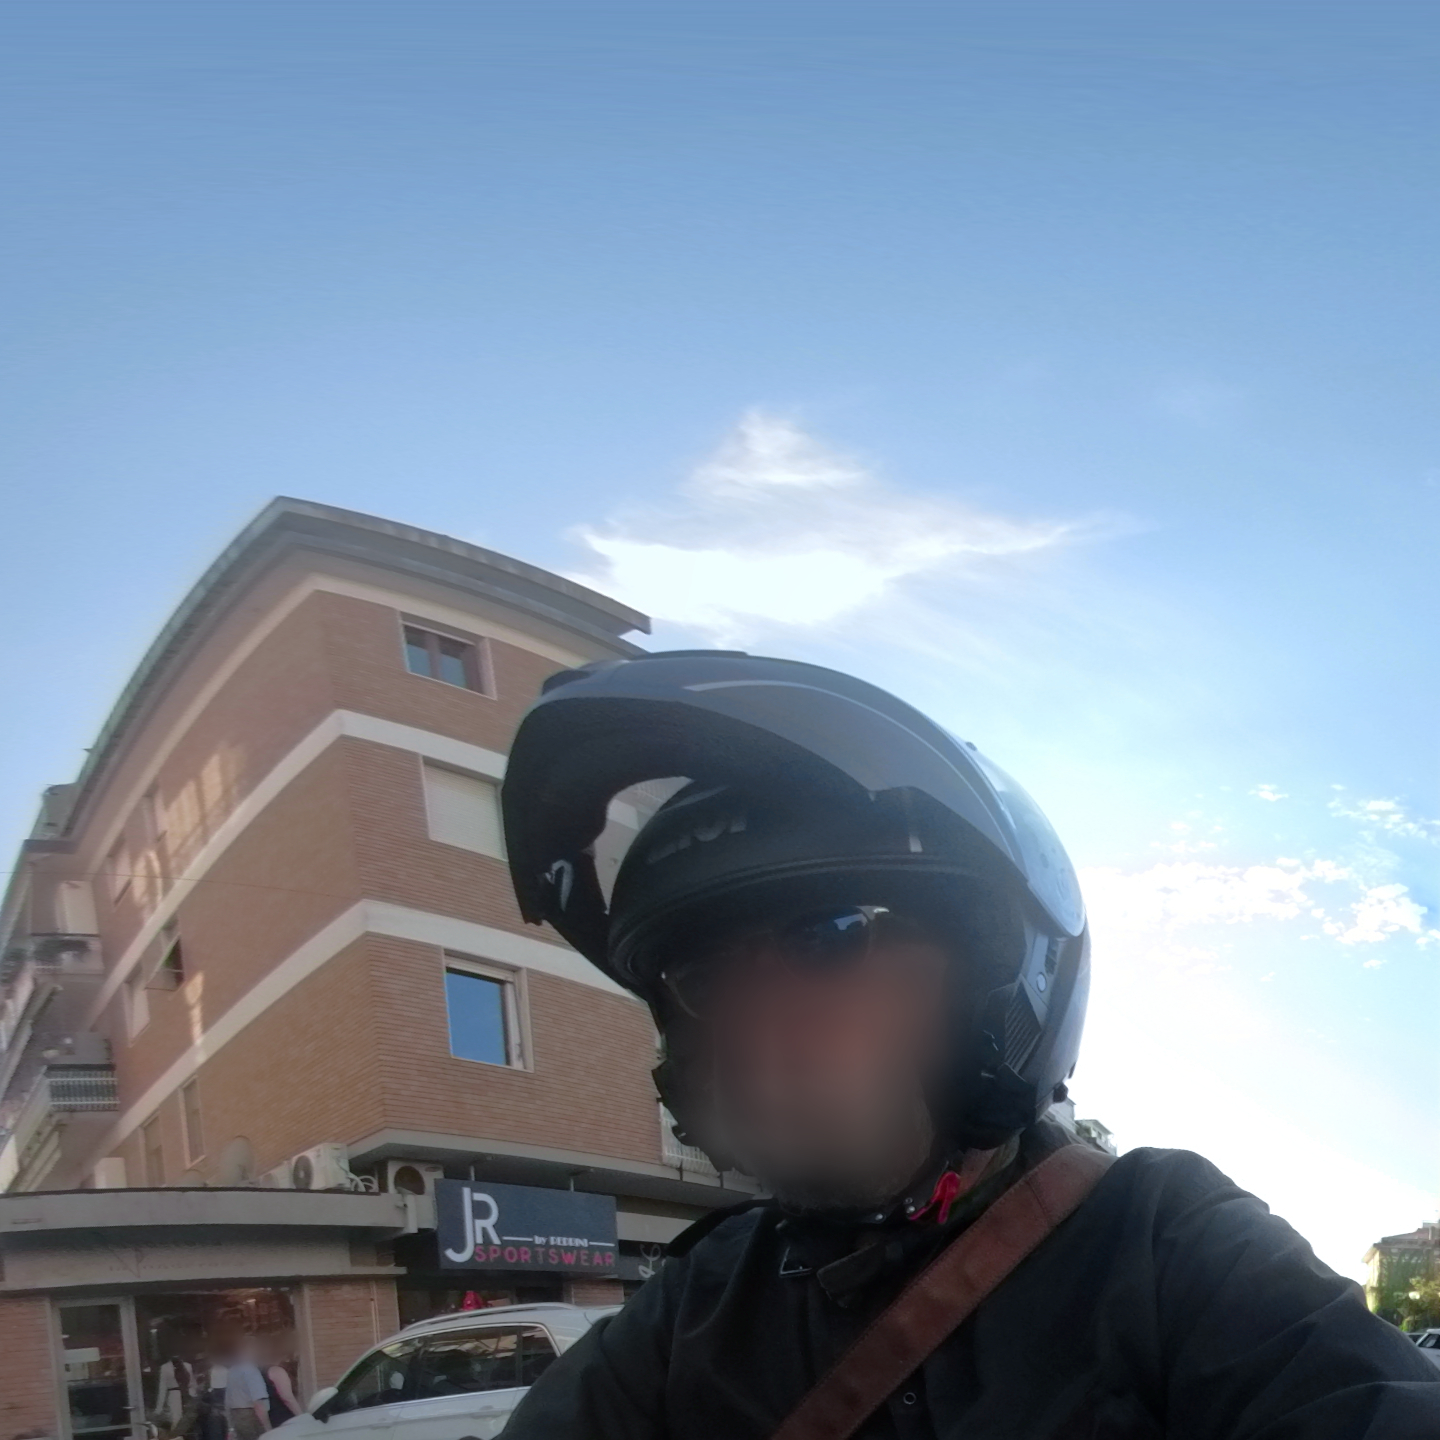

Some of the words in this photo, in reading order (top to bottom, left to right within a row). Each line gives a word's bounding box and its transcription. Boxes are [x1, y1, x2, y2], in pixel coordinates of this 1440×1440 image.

[444, 1187, 502, 1263] JR
[534, 1235, 548, 1245] by
[474, 1245, 616, 1267] SPORTSWEAR
